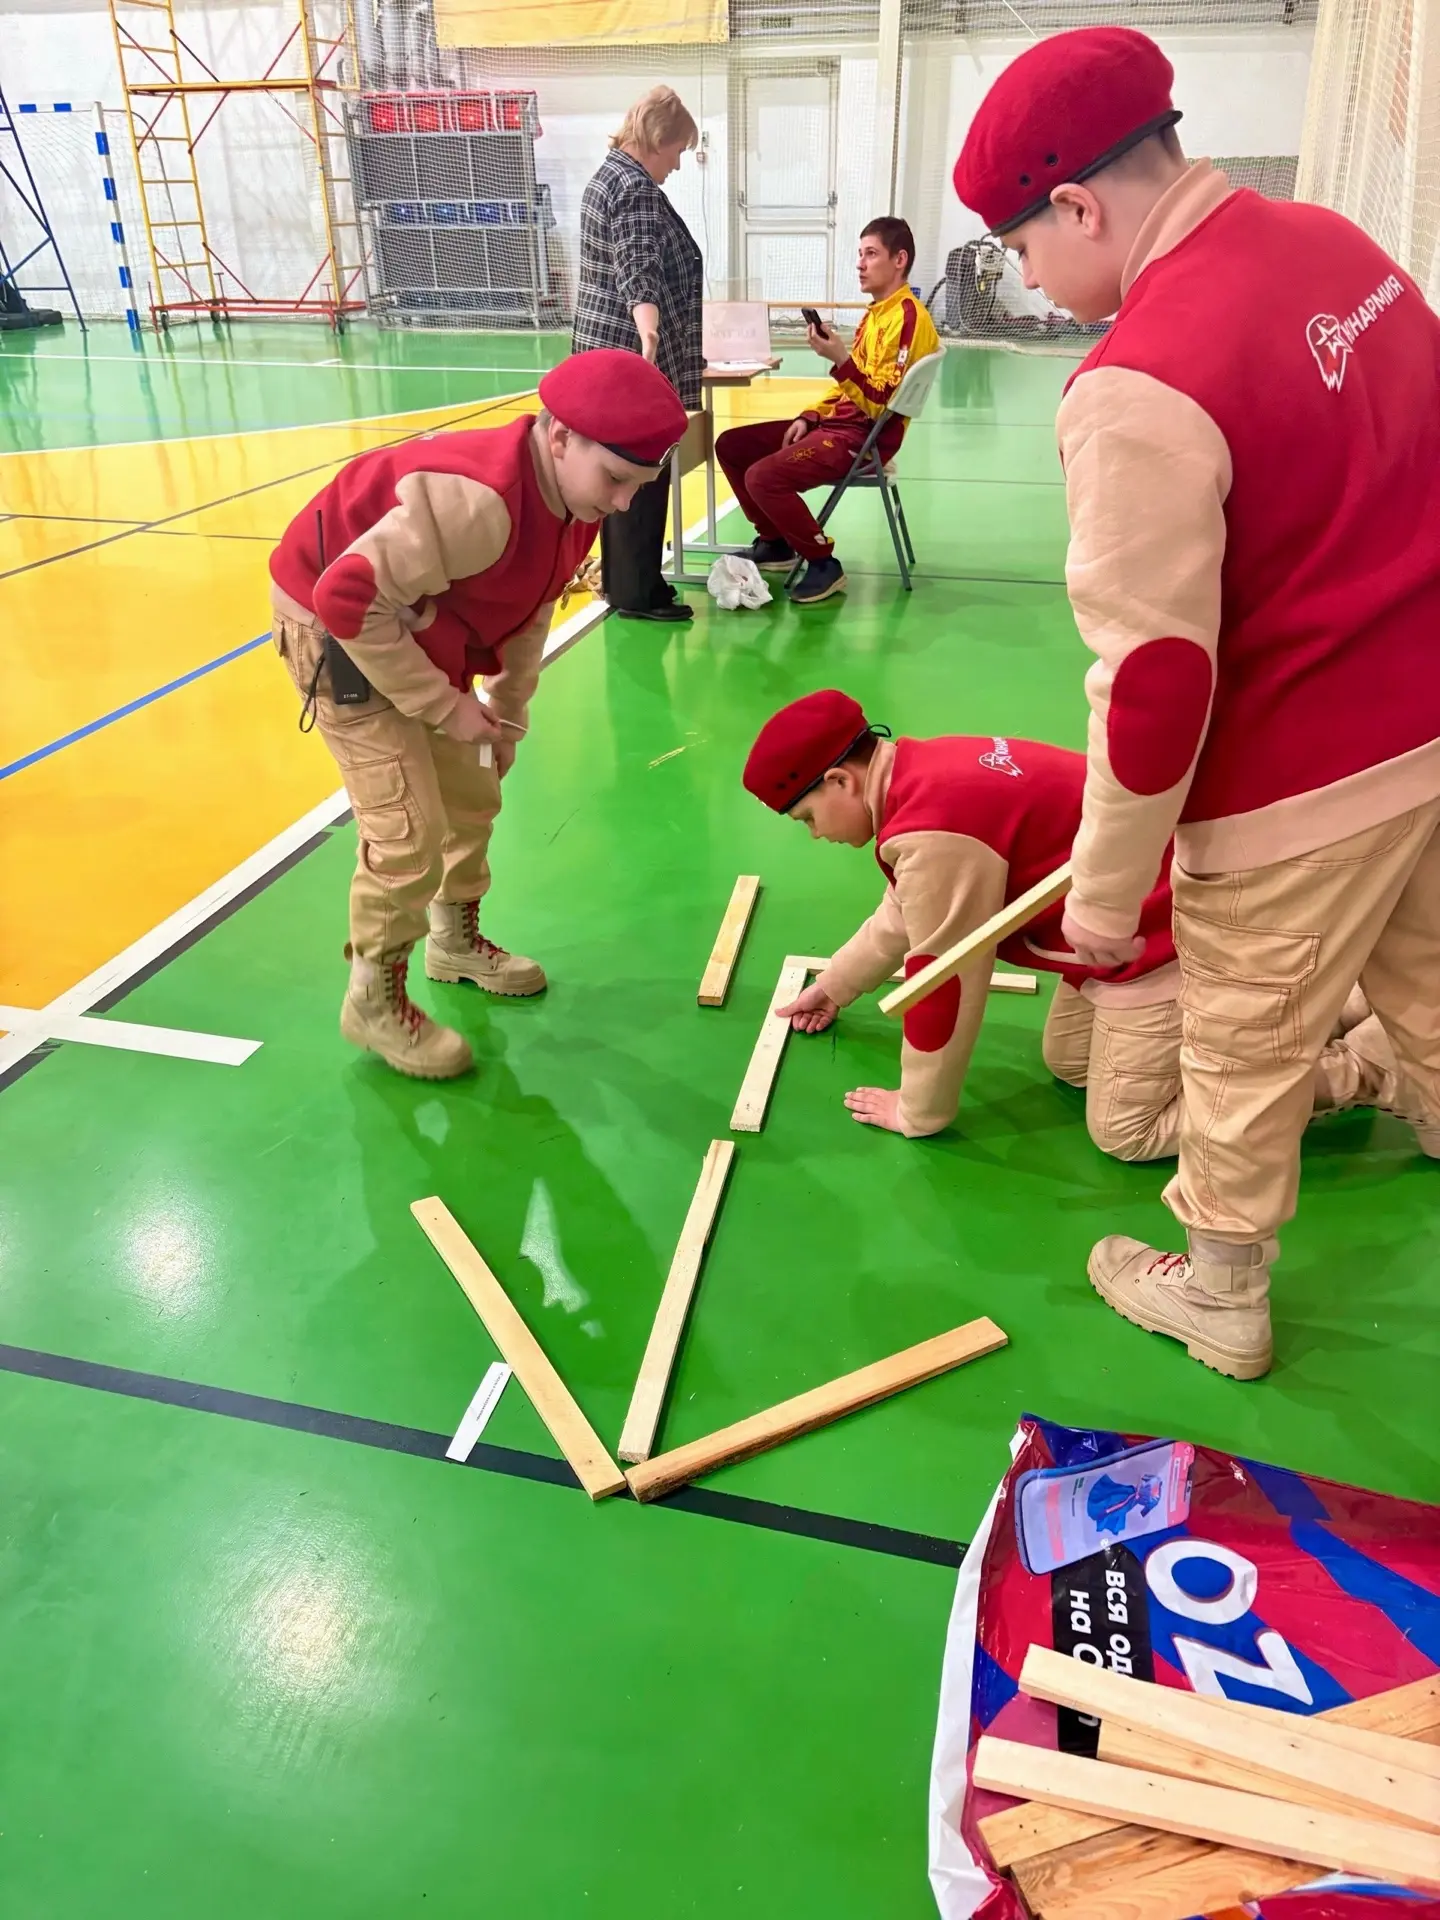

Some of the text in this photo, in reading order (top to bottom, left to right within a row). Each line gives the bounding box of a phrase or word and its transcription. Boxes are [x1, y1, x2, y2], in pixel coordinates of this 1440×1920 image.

[1069, 1589, 1092, 1635] на
[1105, 1569, 1134, 1679] вся од
